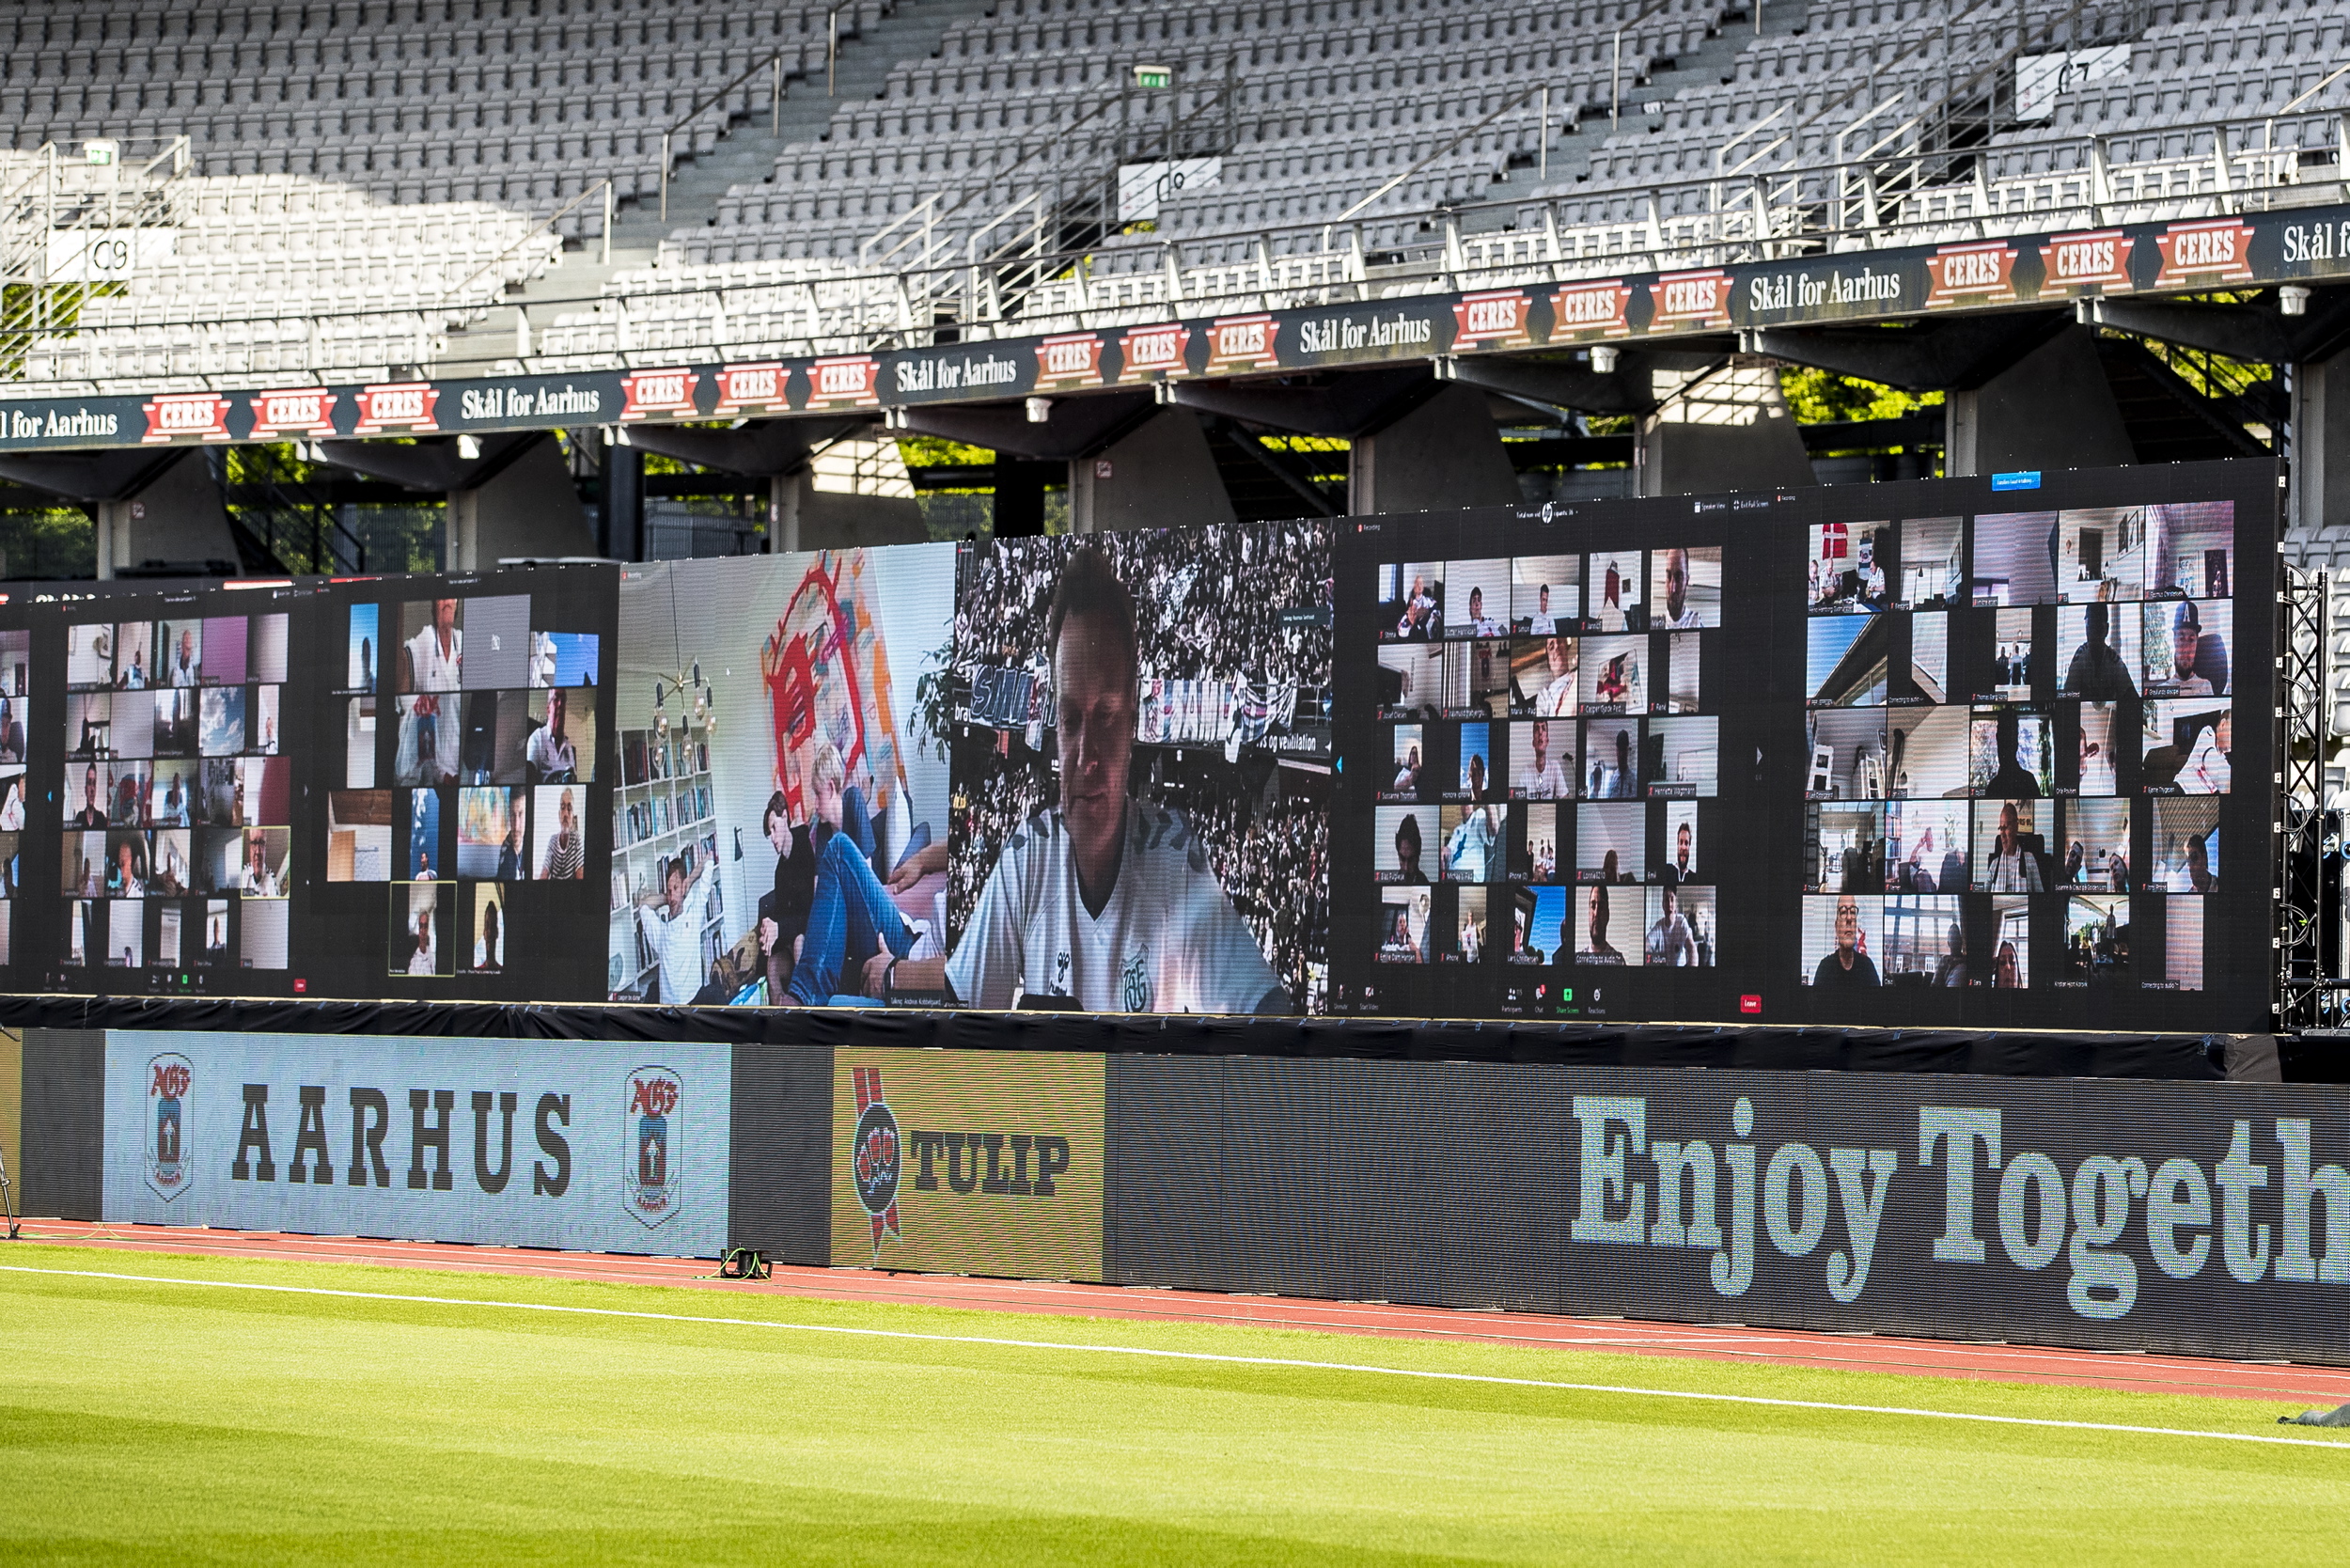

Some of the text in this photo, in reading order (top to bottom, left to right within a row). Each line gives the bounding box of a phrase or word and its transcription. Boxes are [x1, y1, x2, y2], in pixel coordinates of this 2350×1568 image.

[2058, 62, 2090, 94] C7
[94, 241, 127, 270] C9
[2056, 240, 2115, 277] CERES
[2174, 228, 2235, 266] CERES
[2283, 223, 2333, 263] Skål
[1943, 251, 2000, 288] CERES
[1665, 279, 1716, 313] CERES
[1749, 267, 1901, 312] Skål for Aarhus
[1467, 299, 1517, 331] CERES
[1565, 290, 1616, 323] CERES
[1219, 323, 1265, 356] CERES
[1299, 313, 1431, 353] Skål for Aarhus
[1047, 342, 1091, 373] CERES
[1132, 334, 1176, 365] CERES
[635, 375, 684, 404] CERES
[729, 370, 776, 400] CERES
[820, 364, 866, 393] CERES
[897, 354, 1017, 393] Skål for Aarhus
[160, 400, 215, 429] CERES
[267, 396, 321, 424] CERES
[370, 391, 424, 419] CERES
[462, 384, 601, 419] Skål for Aarhus
[12, 410, 42, 438] for
[43, 408, 118, 437] Aarhus
[2182, 604, 2191, 622] A
[1279, 735, 1316, 752] ventilation
[1501, 1005, 1523, 1014] Participants
[1588, 1006, 1606, 1014] Reactions
[1744, 998, 1757, 1008] Leave
[231, 1083, 572, 1198] AARHUS
[910, 1130, 1071, 1197] TULIP
[1571, 1096, 2350, 1318] Enjoy Togeth
